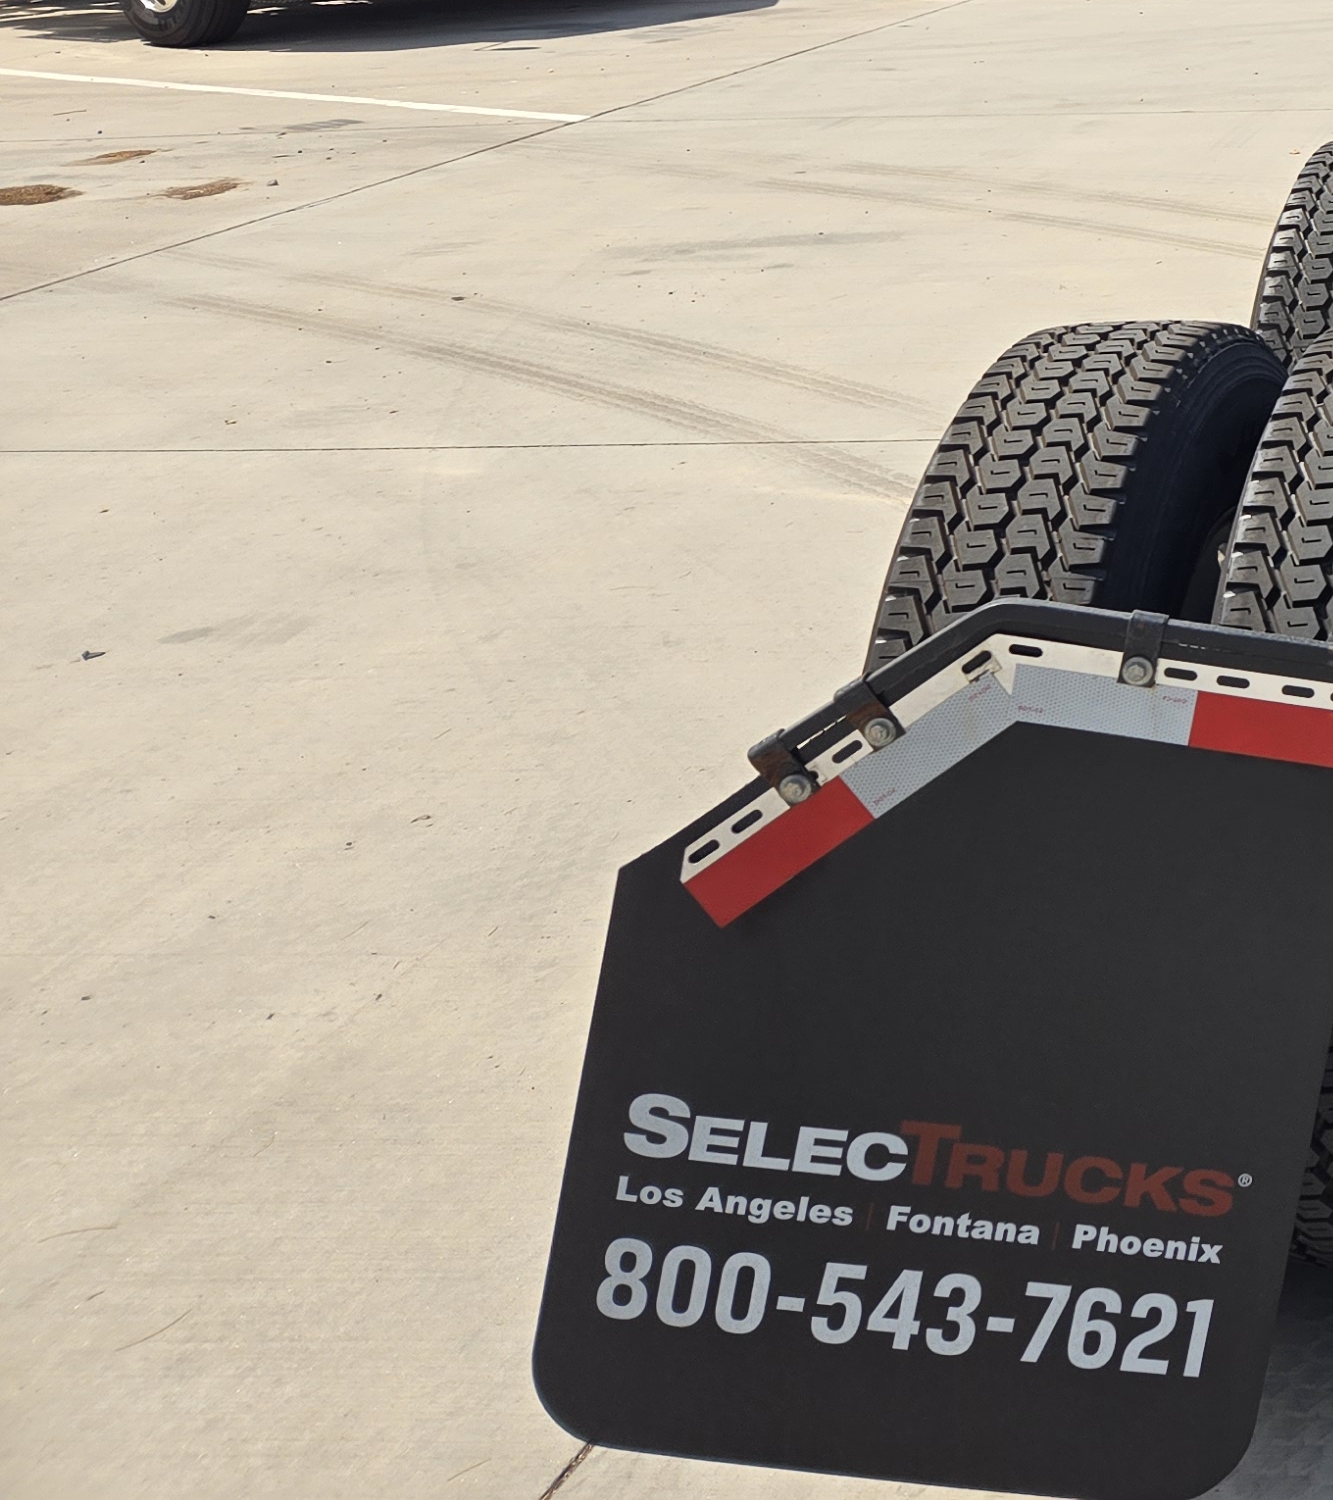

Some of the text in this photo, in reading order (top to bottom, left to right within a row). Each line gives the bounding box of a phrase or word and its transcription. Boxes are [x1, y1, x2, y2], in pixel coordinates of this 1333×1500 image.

[615, 1175, 1223, 1265] Los Angeles Fontana Phoenix
[595, 1236, 1215, 1378] 800-543-7621
